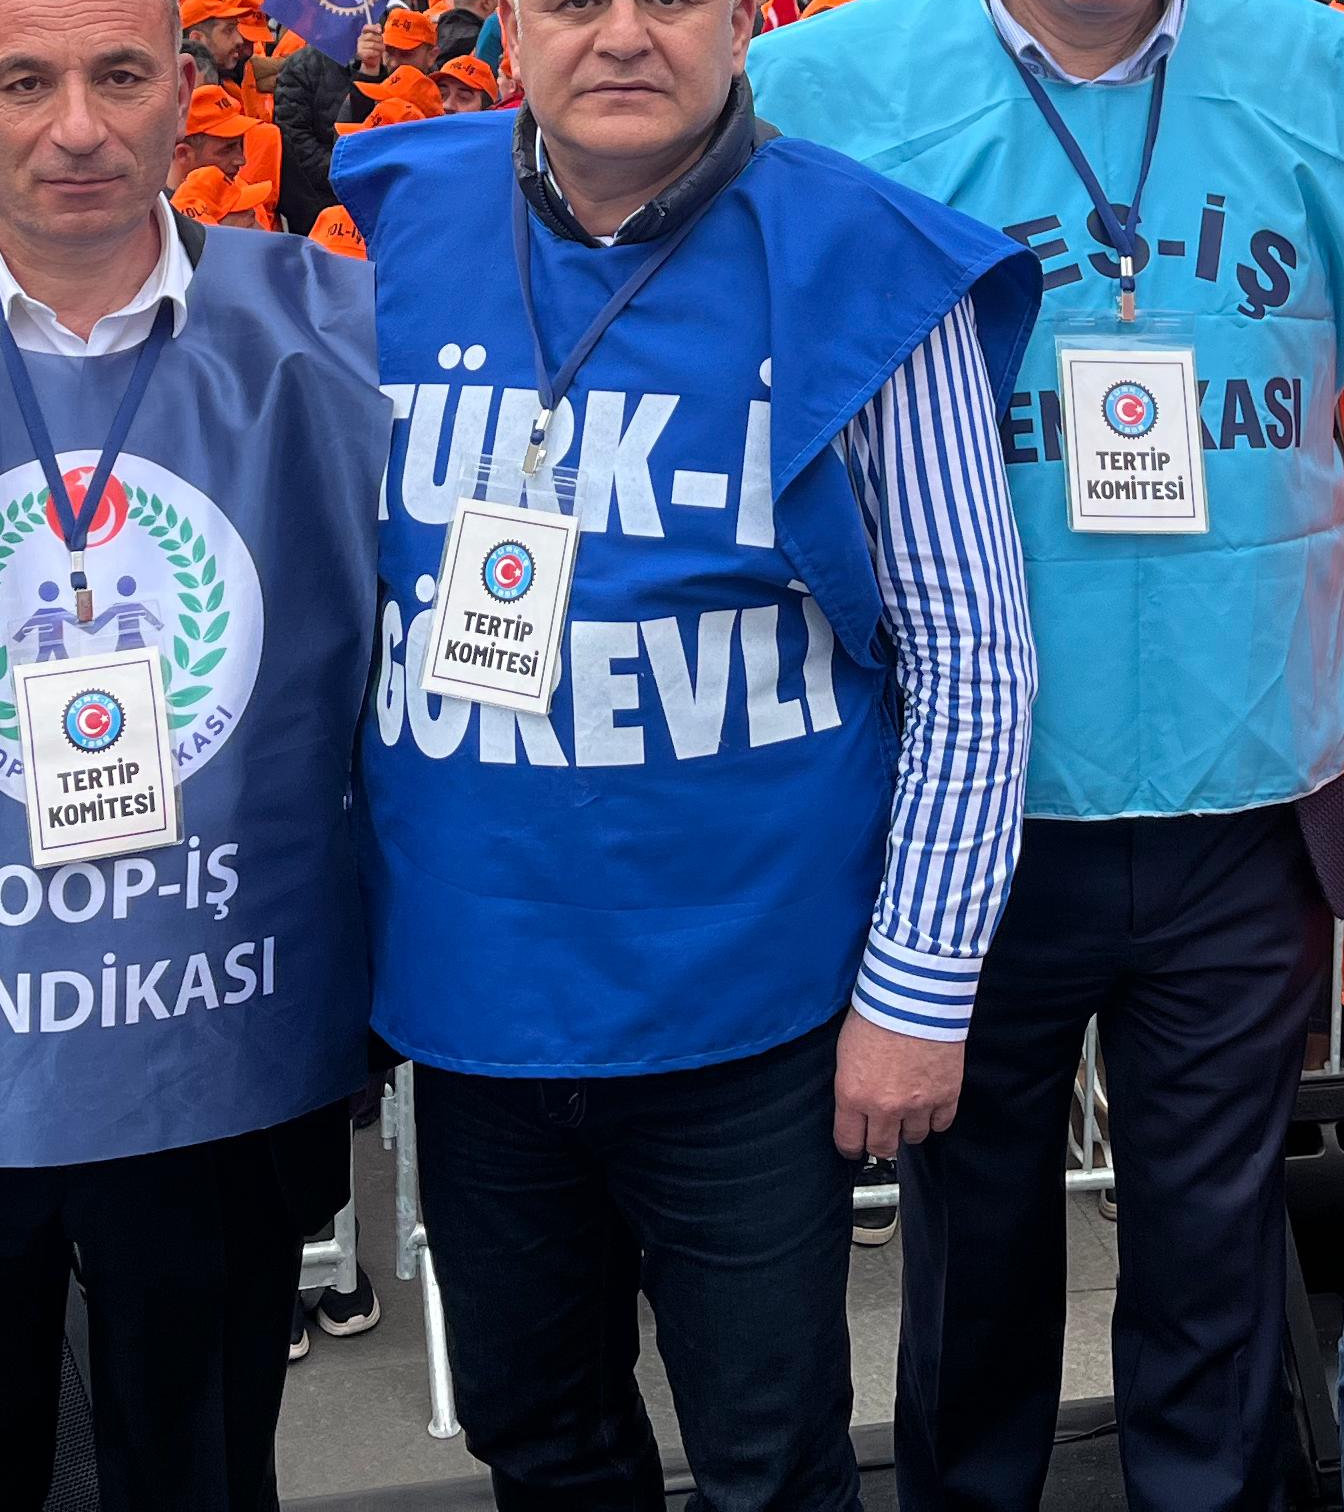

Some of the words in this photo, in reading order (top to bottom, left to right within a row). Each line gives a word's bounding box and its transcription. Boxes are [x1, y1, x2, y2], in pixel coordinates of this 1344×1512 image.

[1001, 192, 1297, 320] ES-İŞ
[378, 343, 776, 549] TÜRK-İ
[1095, 445, 1172, 472] TERTİP
[1086, 473, 1186, 501] KOMİTESİ
[463, 609, 535, 643] TERTİP
[444, 639, 540, 678] KOMİTESİ
[57, 757, 141, 795] TERTİP
[47, 785, 157, 829] KOMİTESİ
